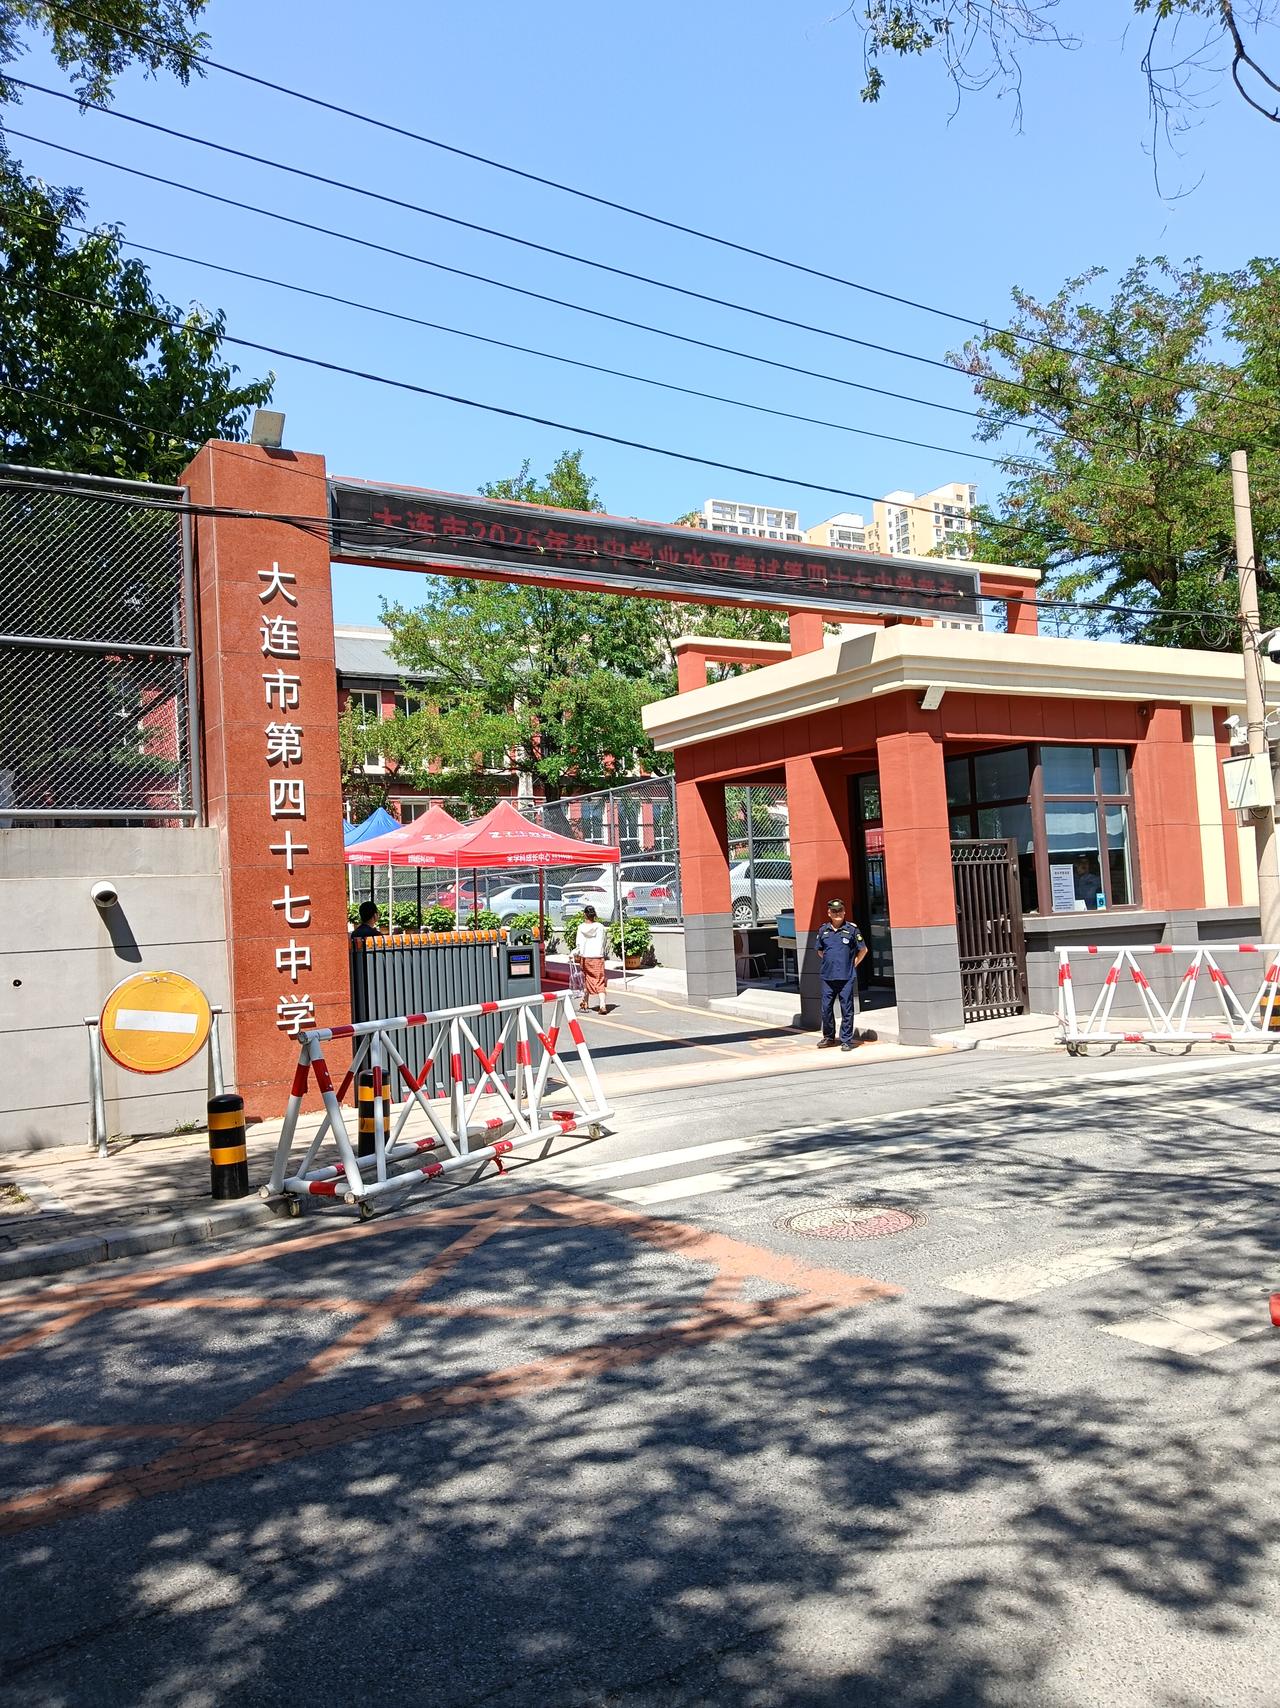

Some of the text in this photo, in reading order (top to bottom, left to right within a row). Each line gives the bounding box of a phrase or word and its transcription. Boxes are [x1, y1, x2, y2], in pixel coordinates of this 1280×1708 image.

[257, 561, 315, 1035] 大连市第四十七中学
